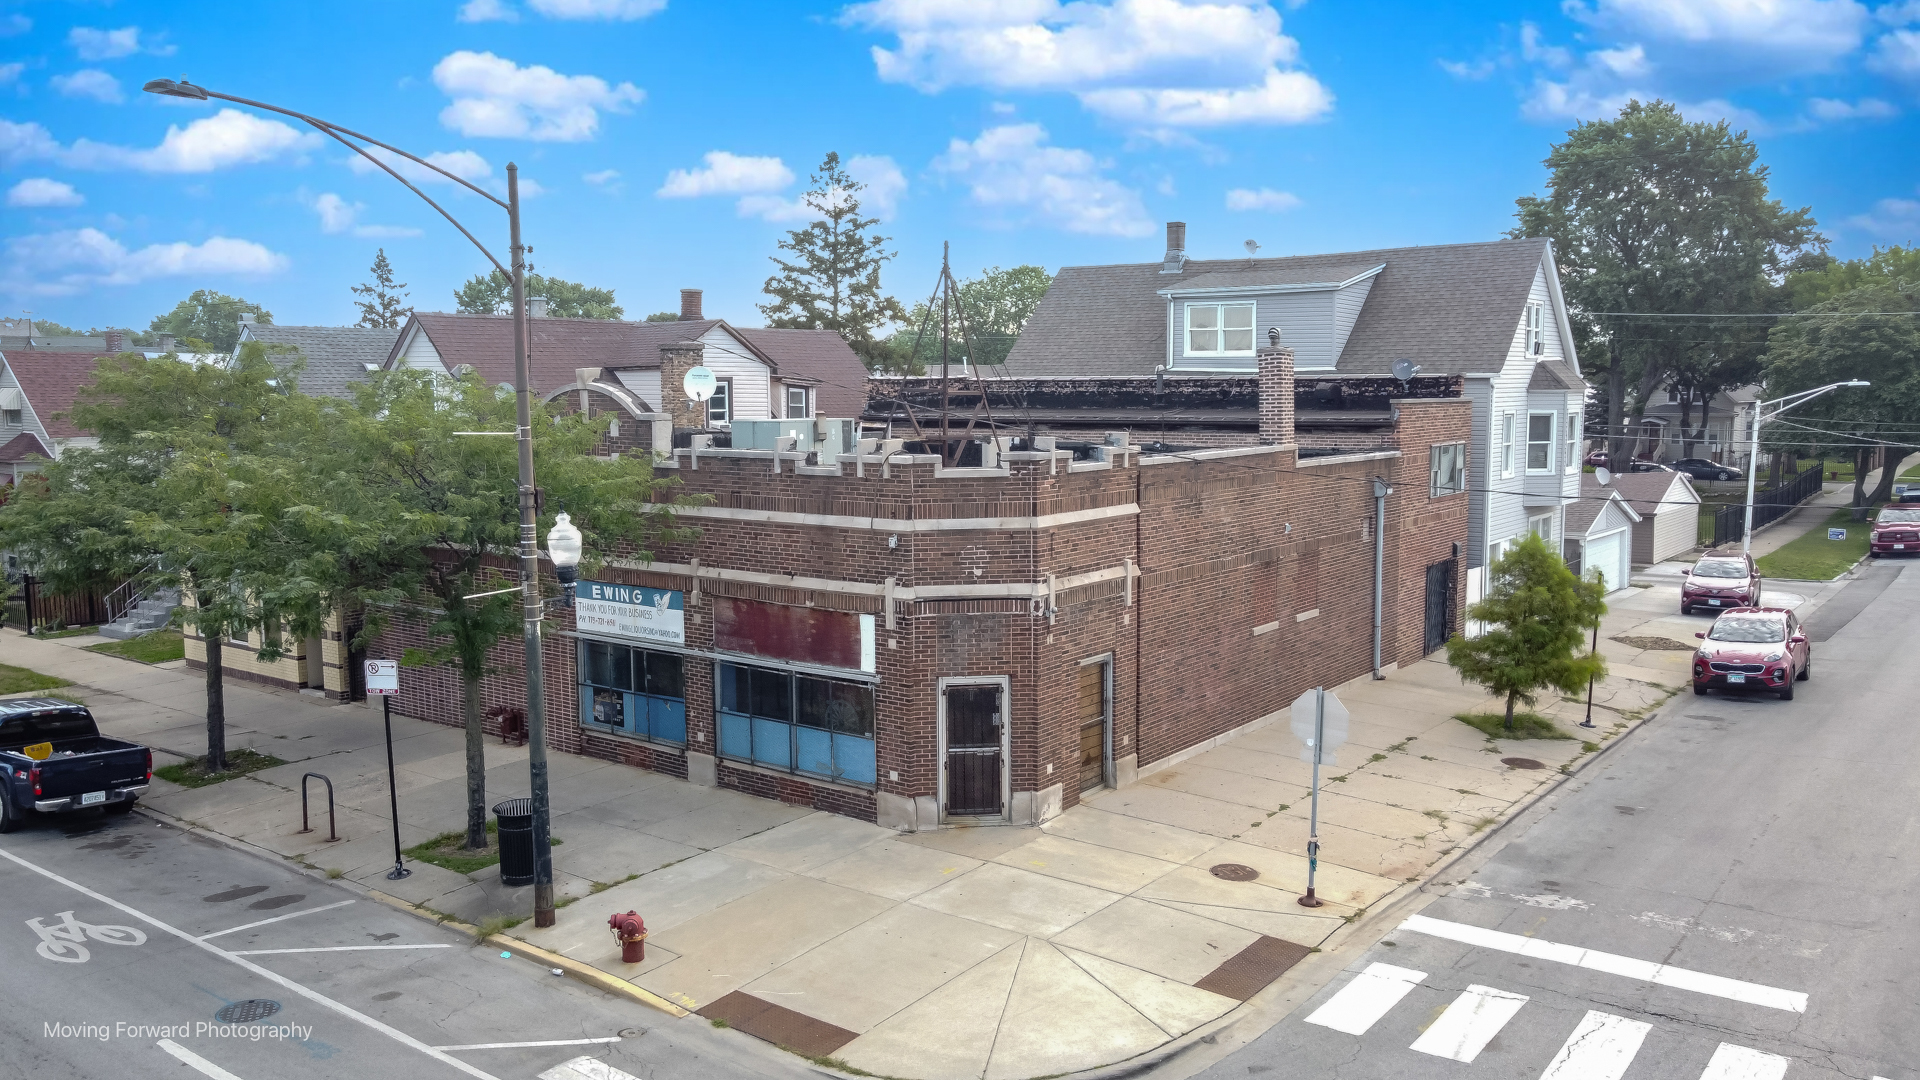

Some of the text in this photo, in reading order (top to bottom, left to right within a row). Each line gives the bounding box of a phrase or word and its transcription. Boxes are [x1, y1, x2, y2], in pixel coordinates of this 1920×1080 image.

[592, 585, 643, 604] EWING
[578, 602, 653, 620] THANK YOU FOR YOUR BUSINESS
